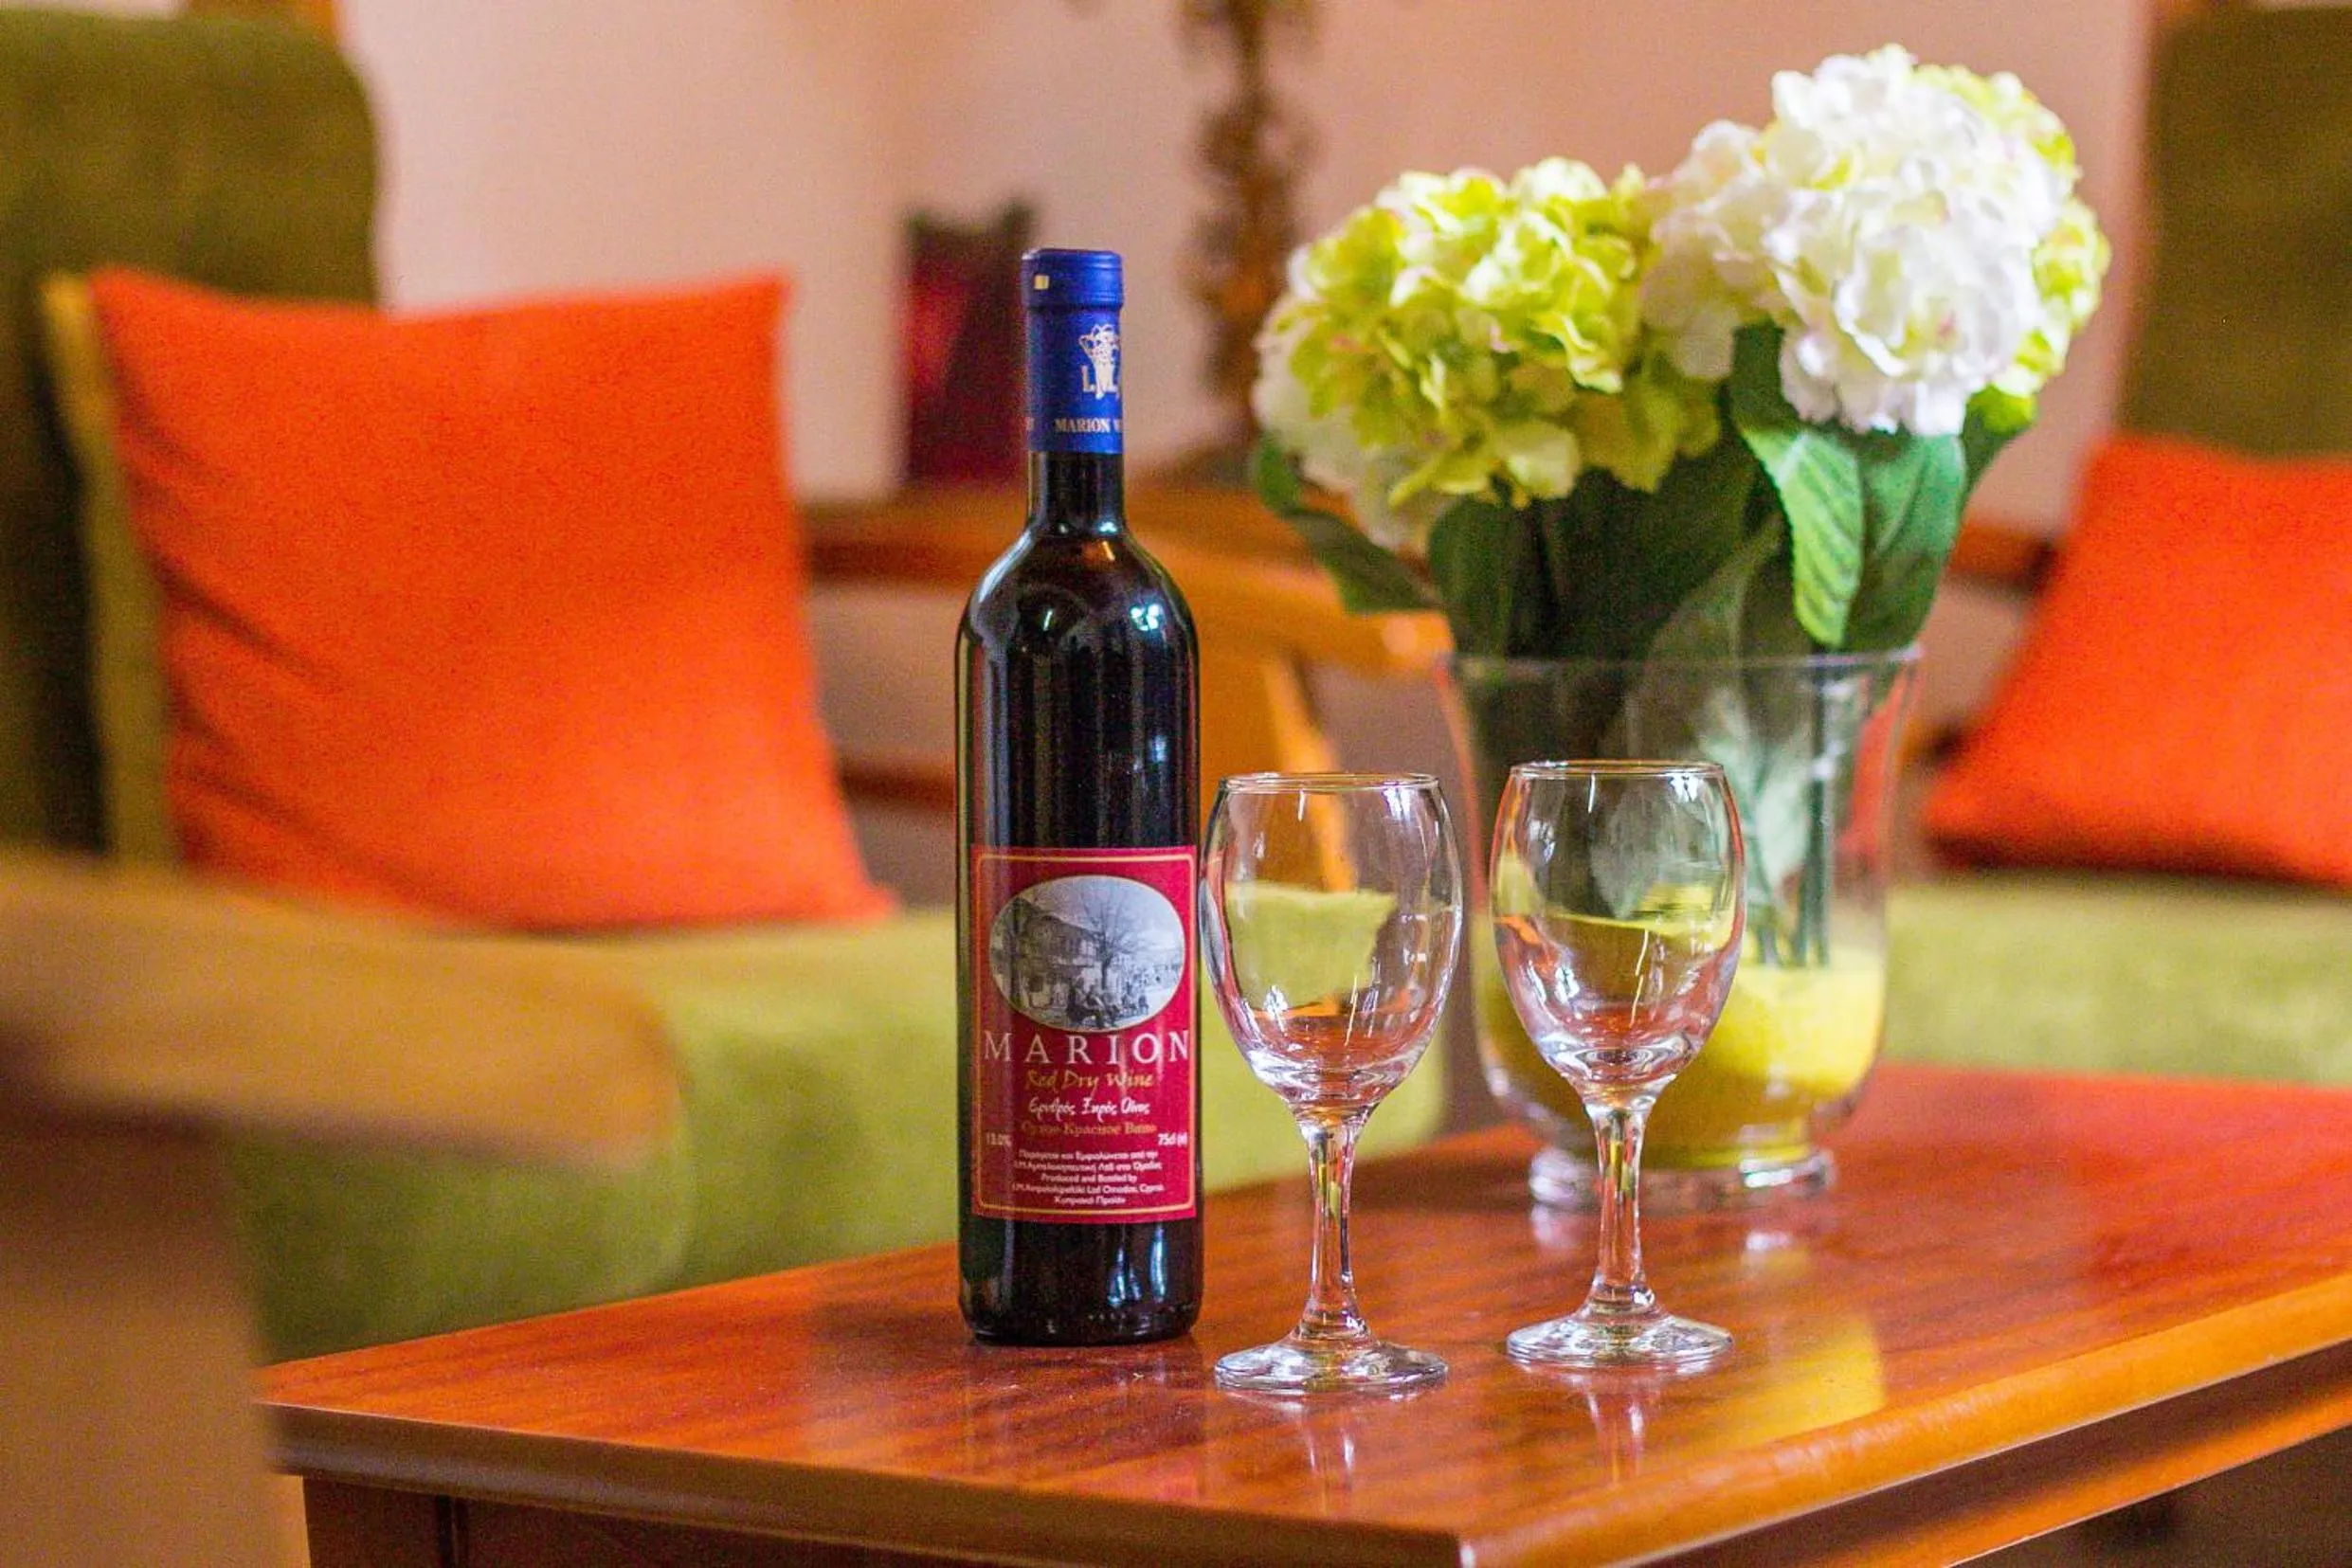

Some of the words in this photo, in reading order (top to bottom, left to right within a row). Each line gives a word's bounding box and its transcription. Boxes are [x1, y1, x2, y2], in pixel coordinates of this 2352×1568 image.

[1054, 417, 1111, 433] MARION
[984, 1030, 1189, 1065] MARION
[1025, 1069, 1058, 1092] Red
[1061, 1069, 1099, 1098] Dry
[1106, 1071, 1153, 1087] Wine
